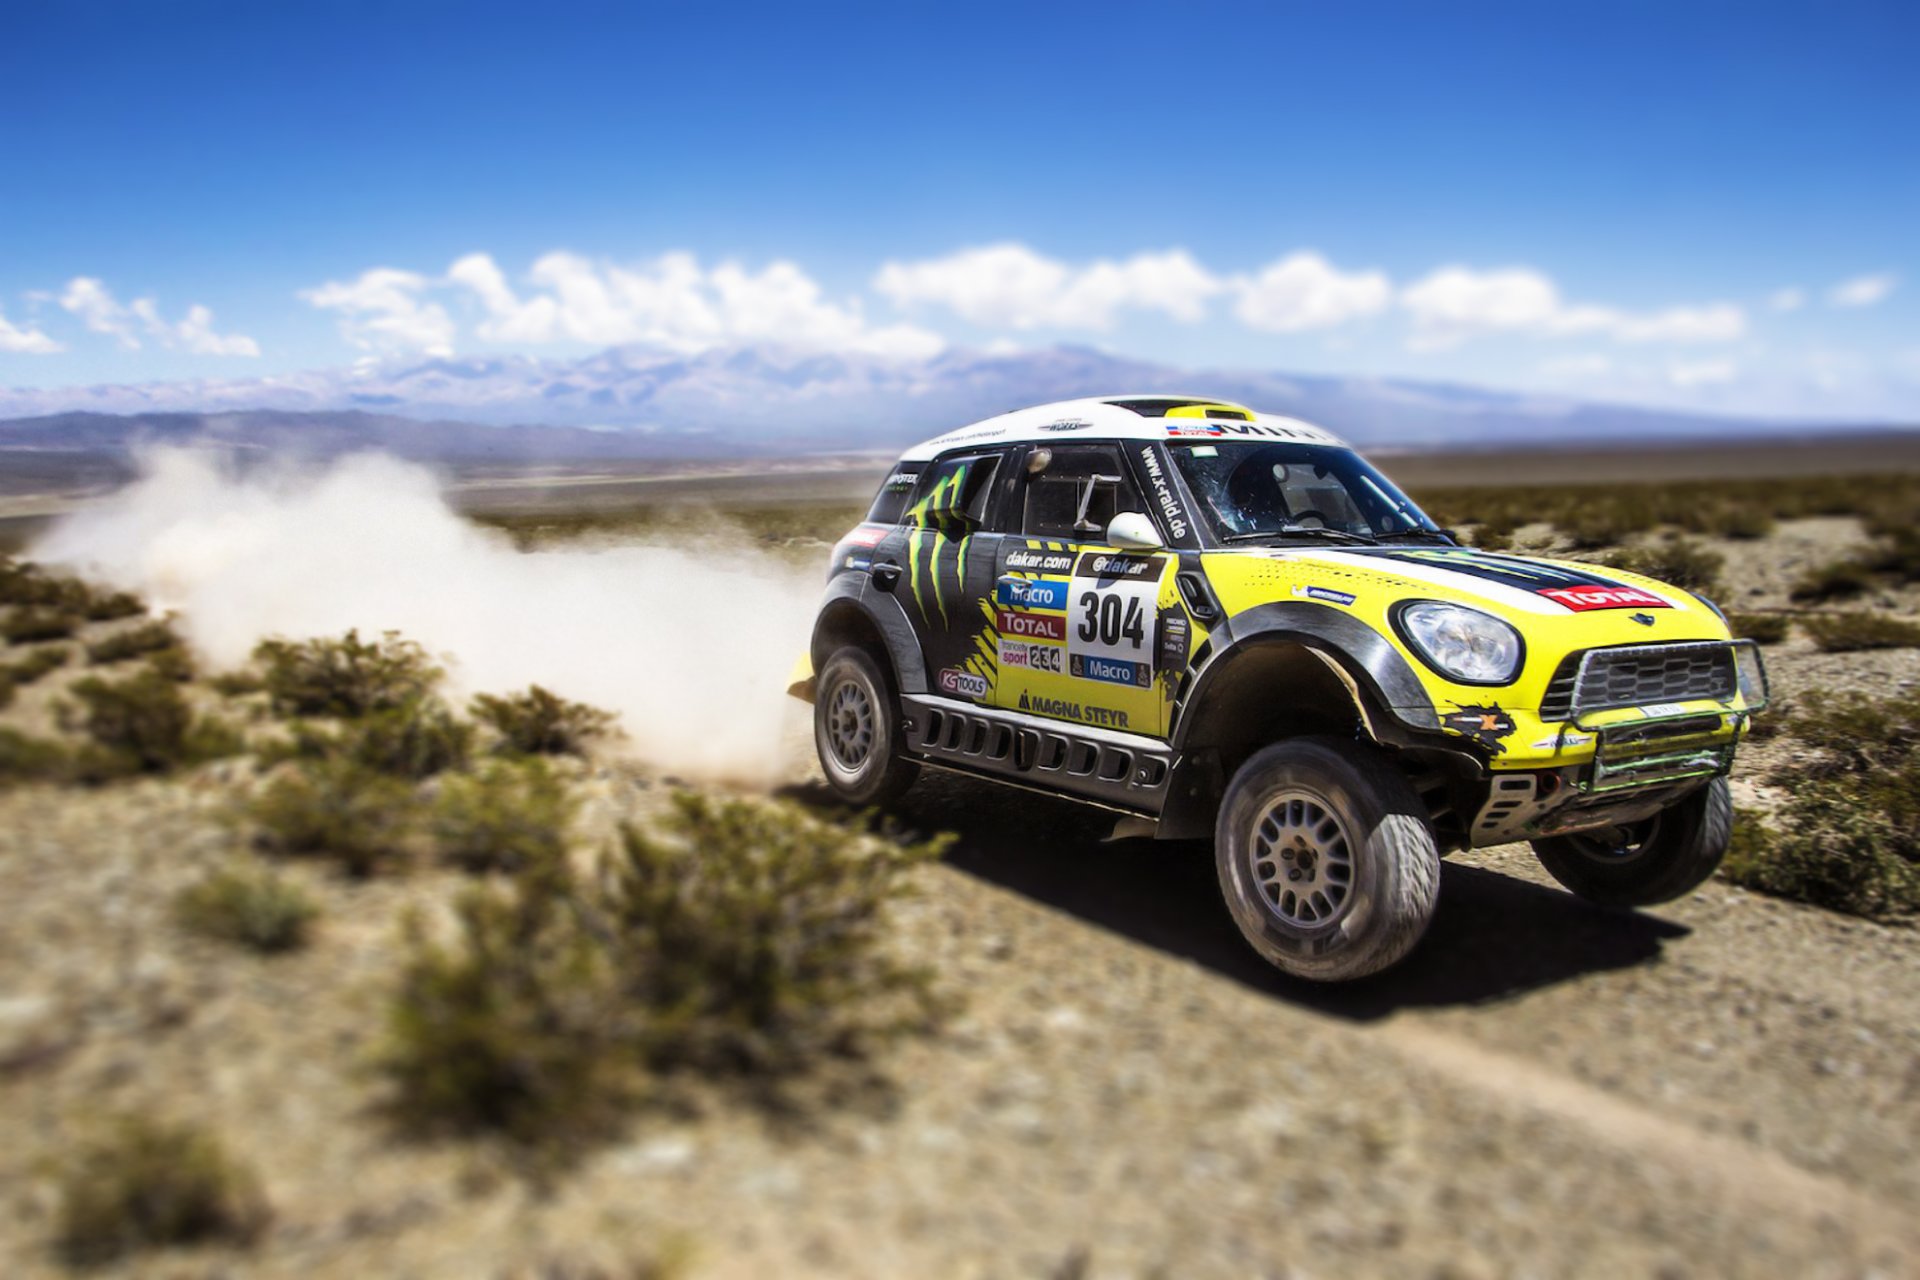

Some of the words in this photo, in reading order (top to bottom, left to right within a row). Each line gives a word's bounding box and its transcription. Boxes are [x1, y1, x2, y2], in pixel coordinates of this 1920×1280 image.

[1140, 446, 1187, 539] www.x-raid.de
[1006, 551, 1072, 570] dakar.com
[1092, 556, 1149, 575] @dakar
[1010, 584, 1054, 604] Macro
[1547, 590, 1663, 606] TOTAL
[1003, 612, 1058, 638] TOTAL
[1078, 591, 1144, 649] 304
[1003, 652, 1027, 665] sport
[1089, 660, 1131, 681] Macro
[958, 676, 984, 693] TOOLS
[1032, 696, 1082, 719] MAGNA
[1085, 706, 1129, 728] STEYR
